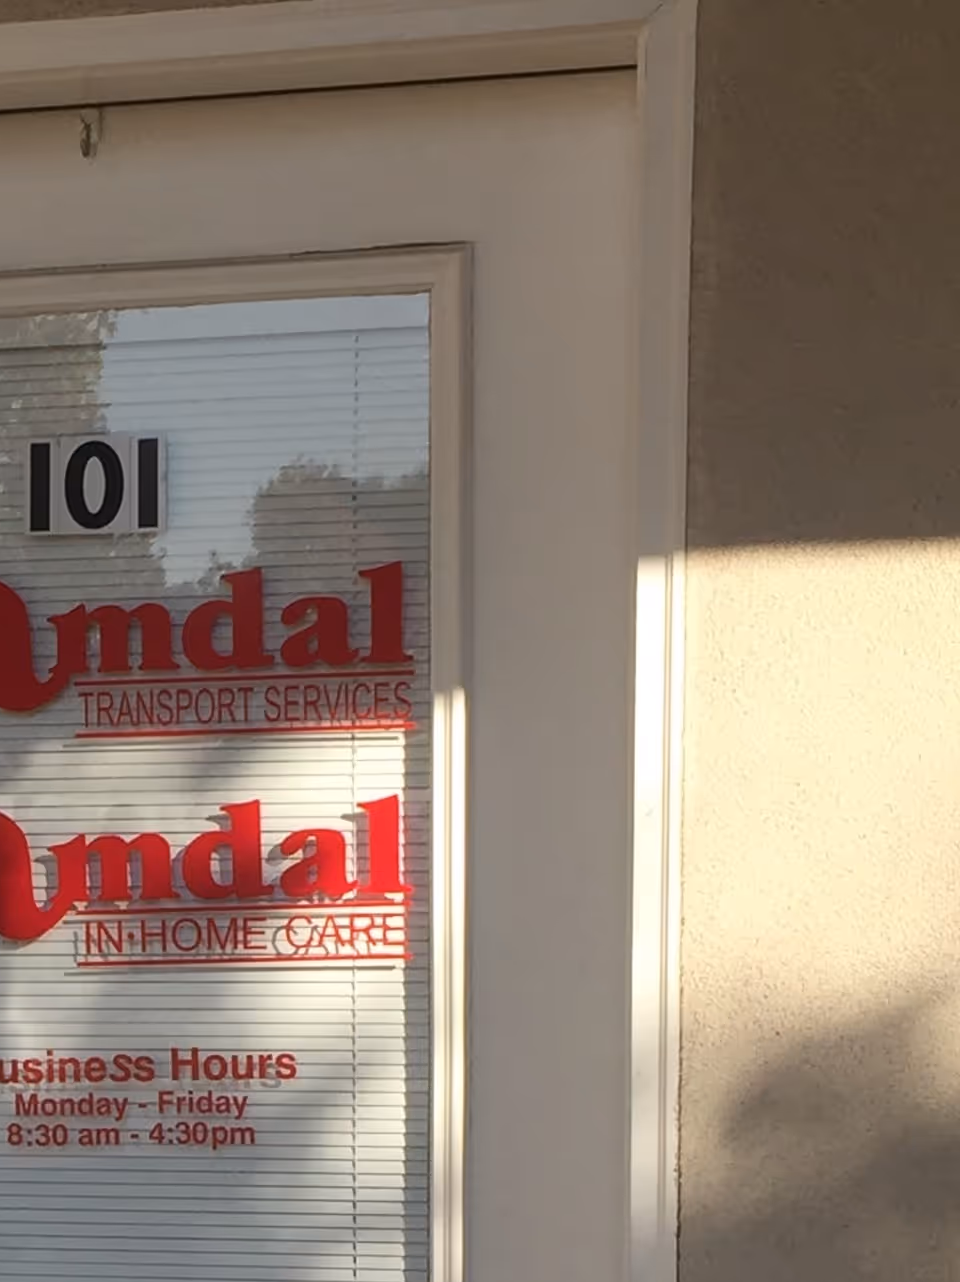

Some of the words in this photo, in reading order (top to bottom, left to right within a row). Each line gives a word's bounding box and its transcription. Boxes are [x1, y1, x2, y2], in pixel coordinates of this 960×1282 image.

[29, 438, 159, 531] 101
[79, 686, 254, 729] TRANSPORT
[263, 681, 414, 722] SERVICES
[284, 913, 408, 949] CARE
[169, 1046, 298, 1082] Hours
[14, 1093, 129, 1122] Monday
[157, 1090, 249, 1119] Friday
[6, 1122, 69, 1148] 8:30
[77, 1128, 120, 1147] am
[147, 1121, 256, 1151] 4:30pm
